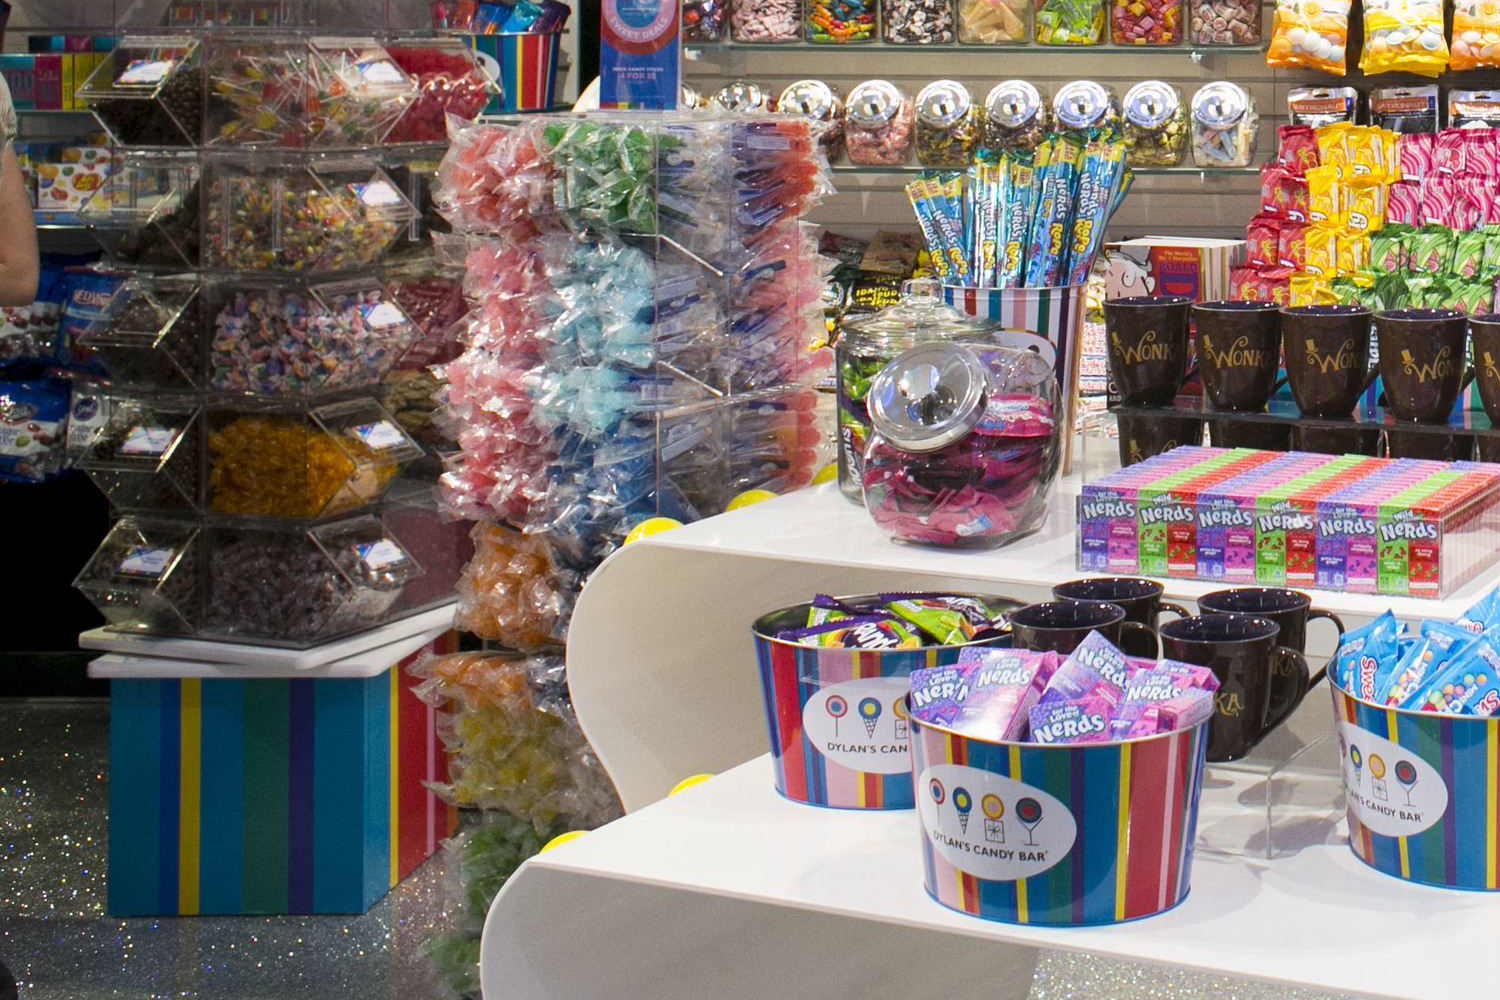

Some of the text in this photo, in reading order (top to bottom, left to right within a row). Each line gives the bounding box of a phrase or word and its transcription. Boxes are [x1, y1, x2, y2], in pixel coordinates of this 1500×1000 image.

[642, 16, 669, 39] DEALS
[1158, 262, 1198, 273] ROALD
[1153, 493, 1172, 505] Wild
[1271, 501, 1291, 513] Wild
[1393, 509, 1414, 522] Wild
[827, 742, 909, 754] DYLAN'S CAN
[1365, 800, 1421, 823] CANDY BAR
[933, 830, 1047, 863] DYLAN'S CANDY BAR
